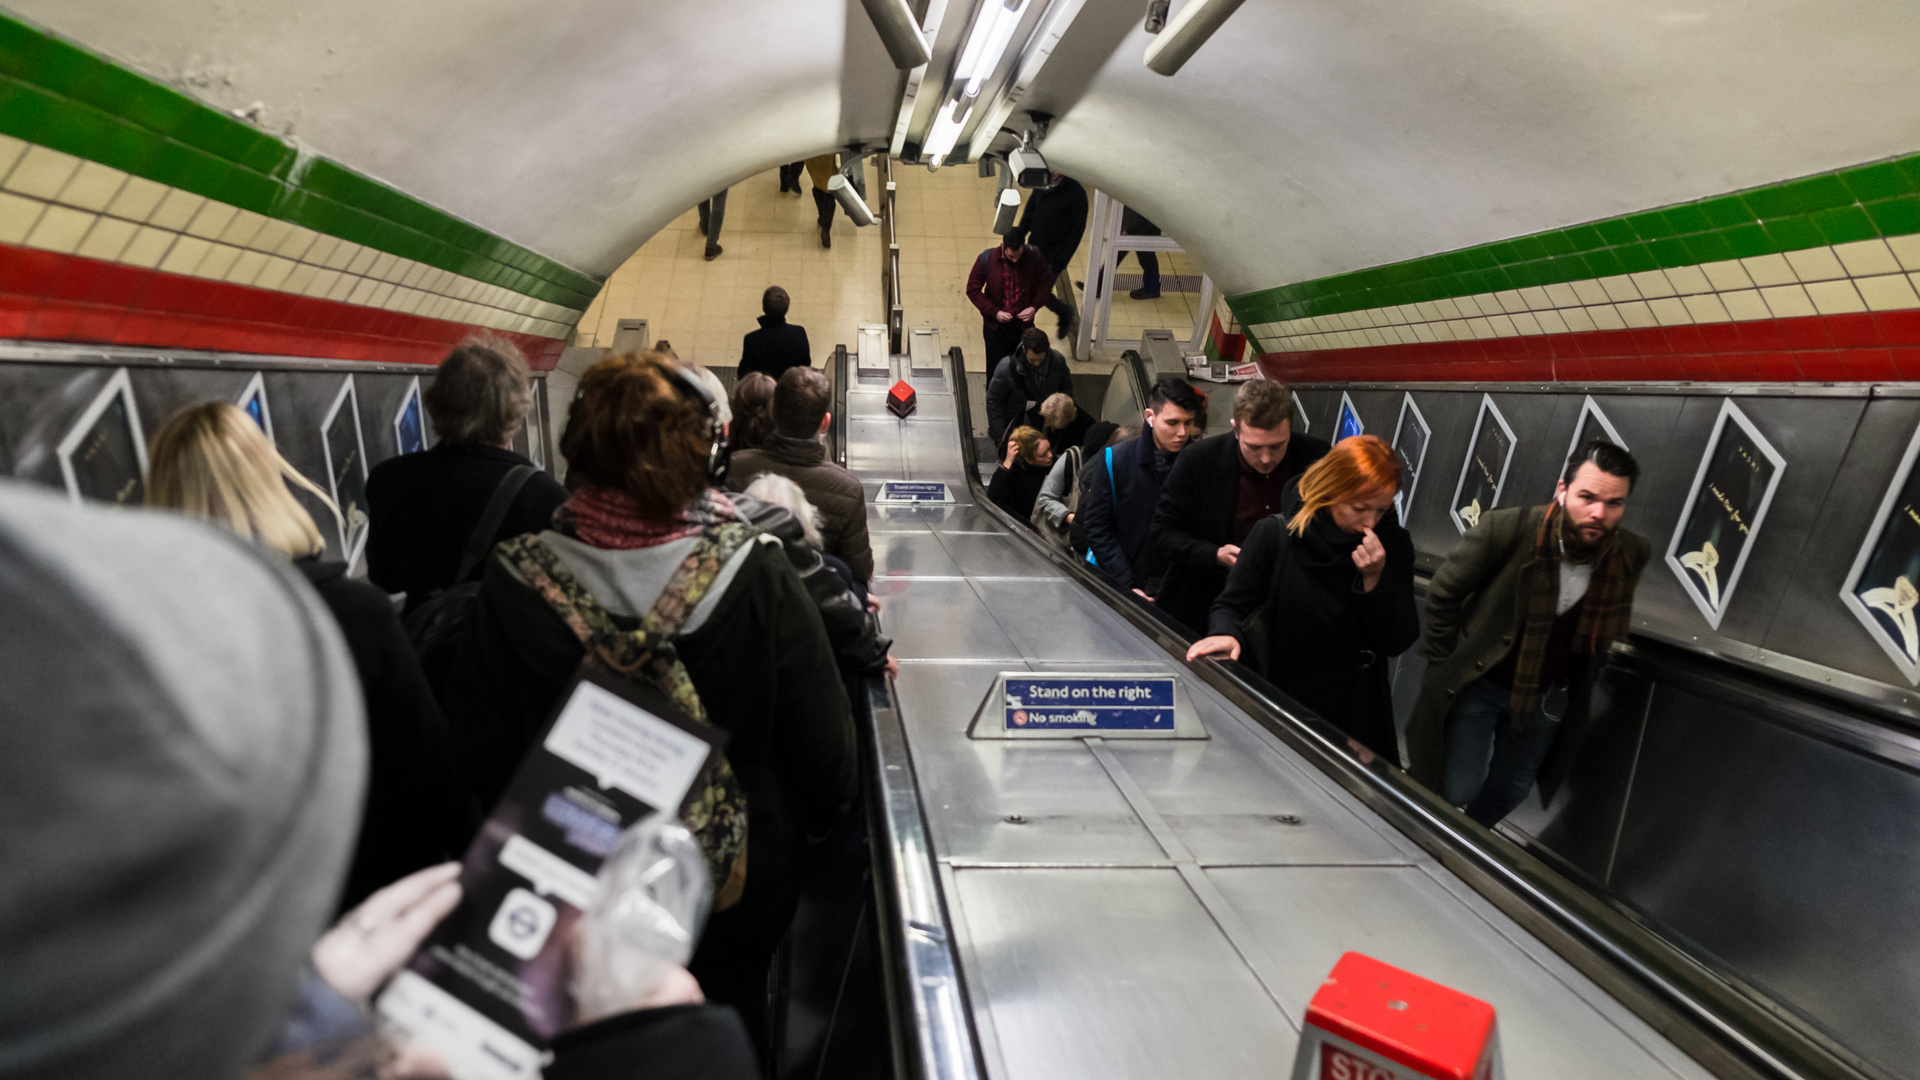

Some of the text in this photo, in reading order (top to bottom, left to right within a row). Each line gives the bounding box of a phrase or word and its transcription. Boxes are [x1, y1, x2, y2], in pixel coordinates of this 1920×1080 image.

[1029, 685, 1151, 701] Stand on the right
[1029, 711, 1047, 724] No
